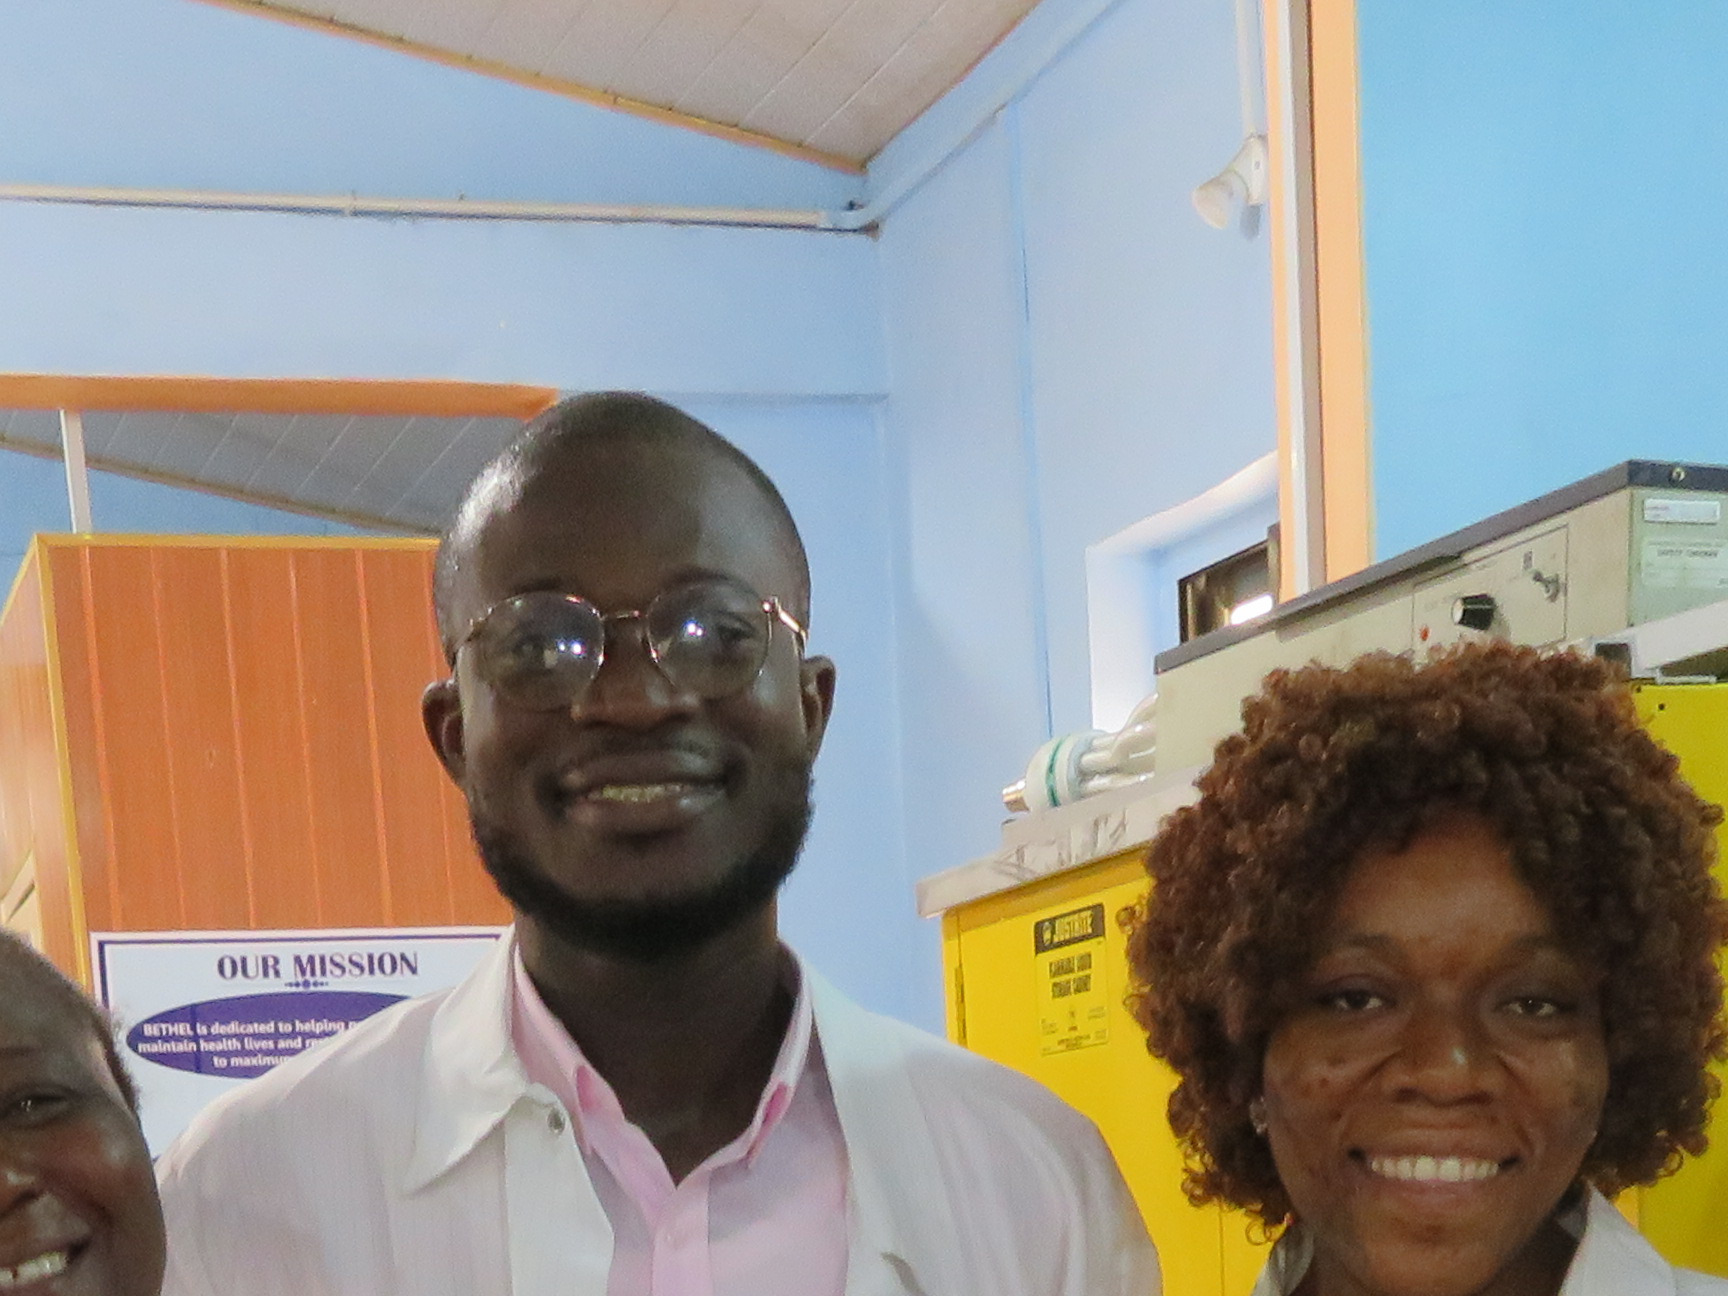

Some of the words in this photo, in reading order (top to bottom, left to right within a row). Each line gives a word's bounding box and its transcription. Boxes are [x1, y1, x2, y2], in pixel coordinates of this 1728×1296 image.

[217, 954, 281, 980] OUR
[293, 951, 419, 978] MISSION
[143, 1022, 194, 1037] BETHEL
[196, 1022, 208, 1035] is
[211, 1020, 274, 1036] dedicated
[278, 1021, 292, 1034] to
[295, 1018, 346, 1034] helping
[138, 1039, 197, 1054] maintain
[199, 1036, 242, 1052] health
[244, 1036, 274, 1051] lives
[277, 1035, 302, 1050] and
[212, 1055, 228, 1068] to
